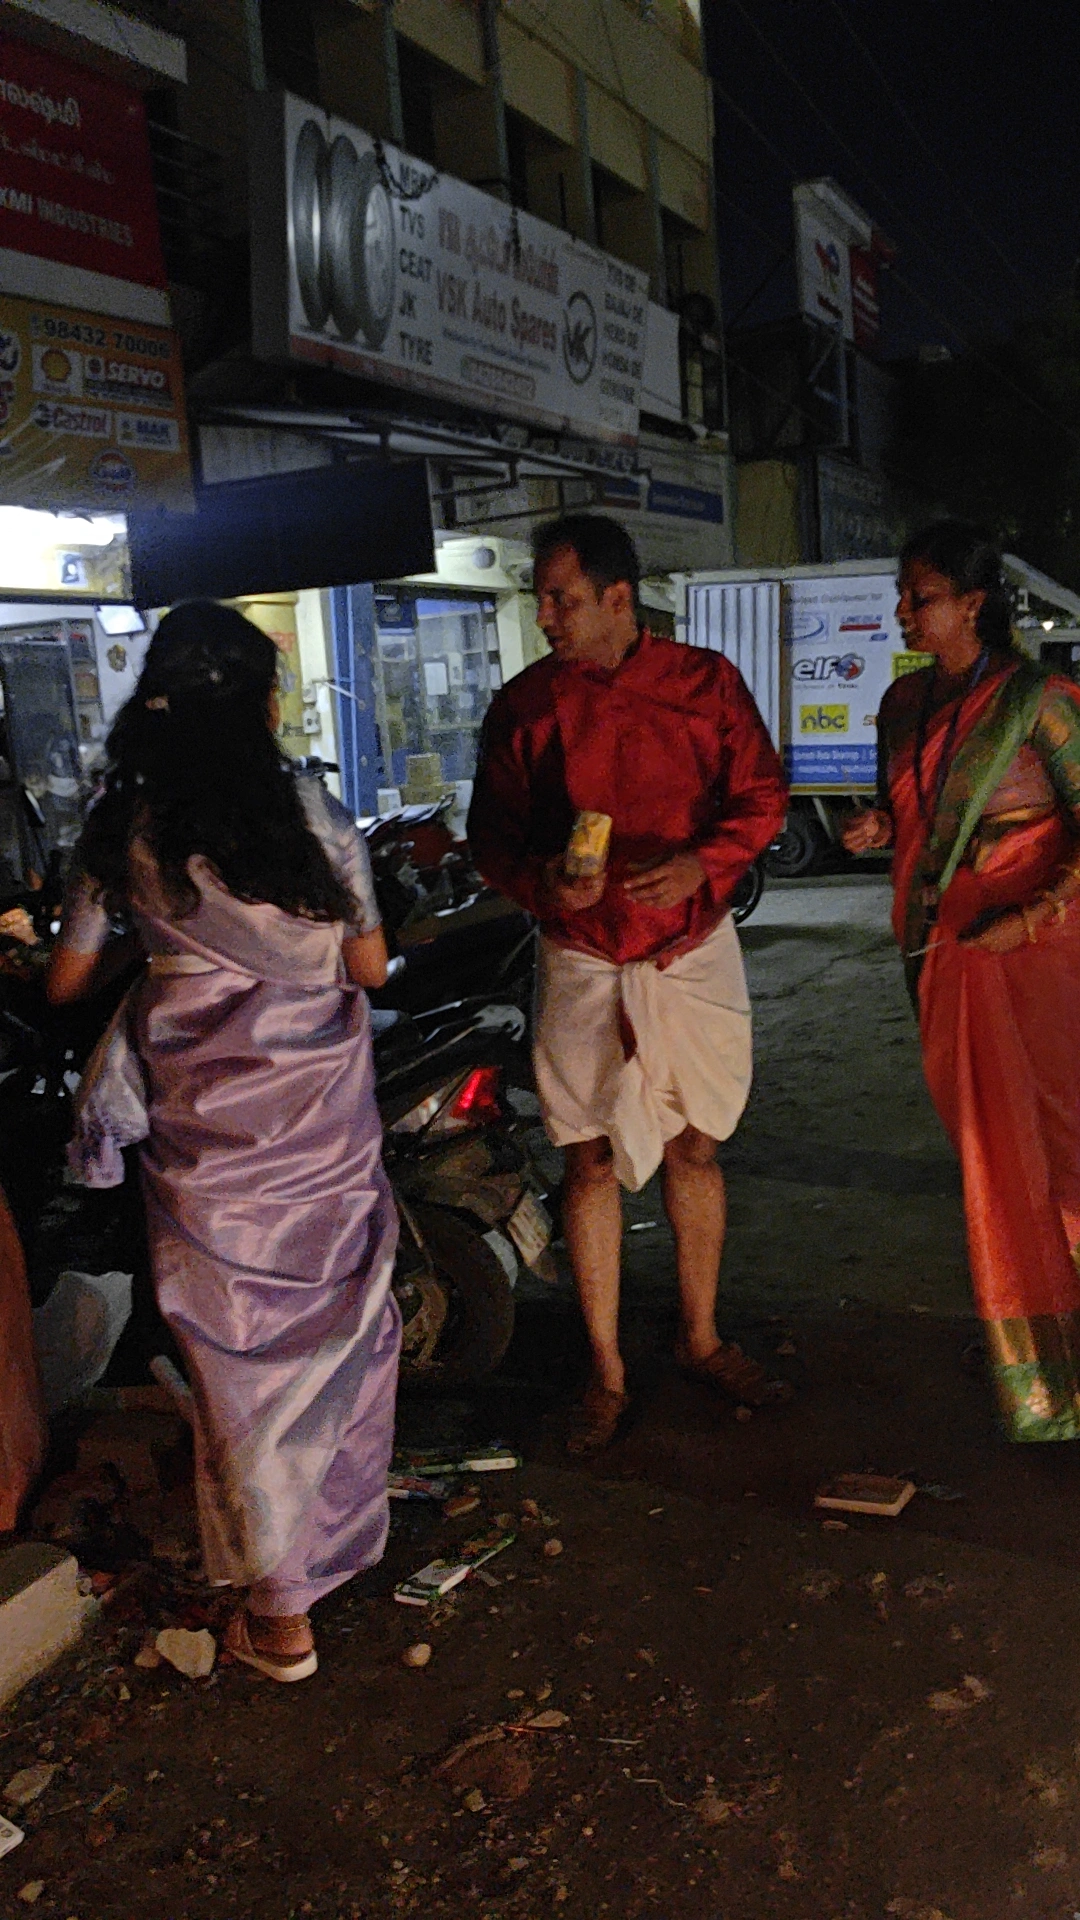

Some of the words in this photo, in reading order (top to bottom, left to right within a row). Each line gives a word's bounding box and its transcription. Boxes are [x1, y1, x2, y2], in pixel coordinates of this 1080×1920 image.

[36, 197, 135, 247] INDUSTRIES
[400, 204, 425, 239] TVS
[399, 248, 433, 283] CEAT
[436, 269, 468, 319] VSK
[472, 281, 507, 334] Auto
[511, 296, 559, 352] Spares
[44, 318, 107, 348] 98432
[399, 331, 433, 366] TYRE
[108, 361, 166, 389] SERVO
[52, 405, 108, 434] Castrol
[792, 656, 839, 681] elf
[802, 707, 846, 729] nbc
